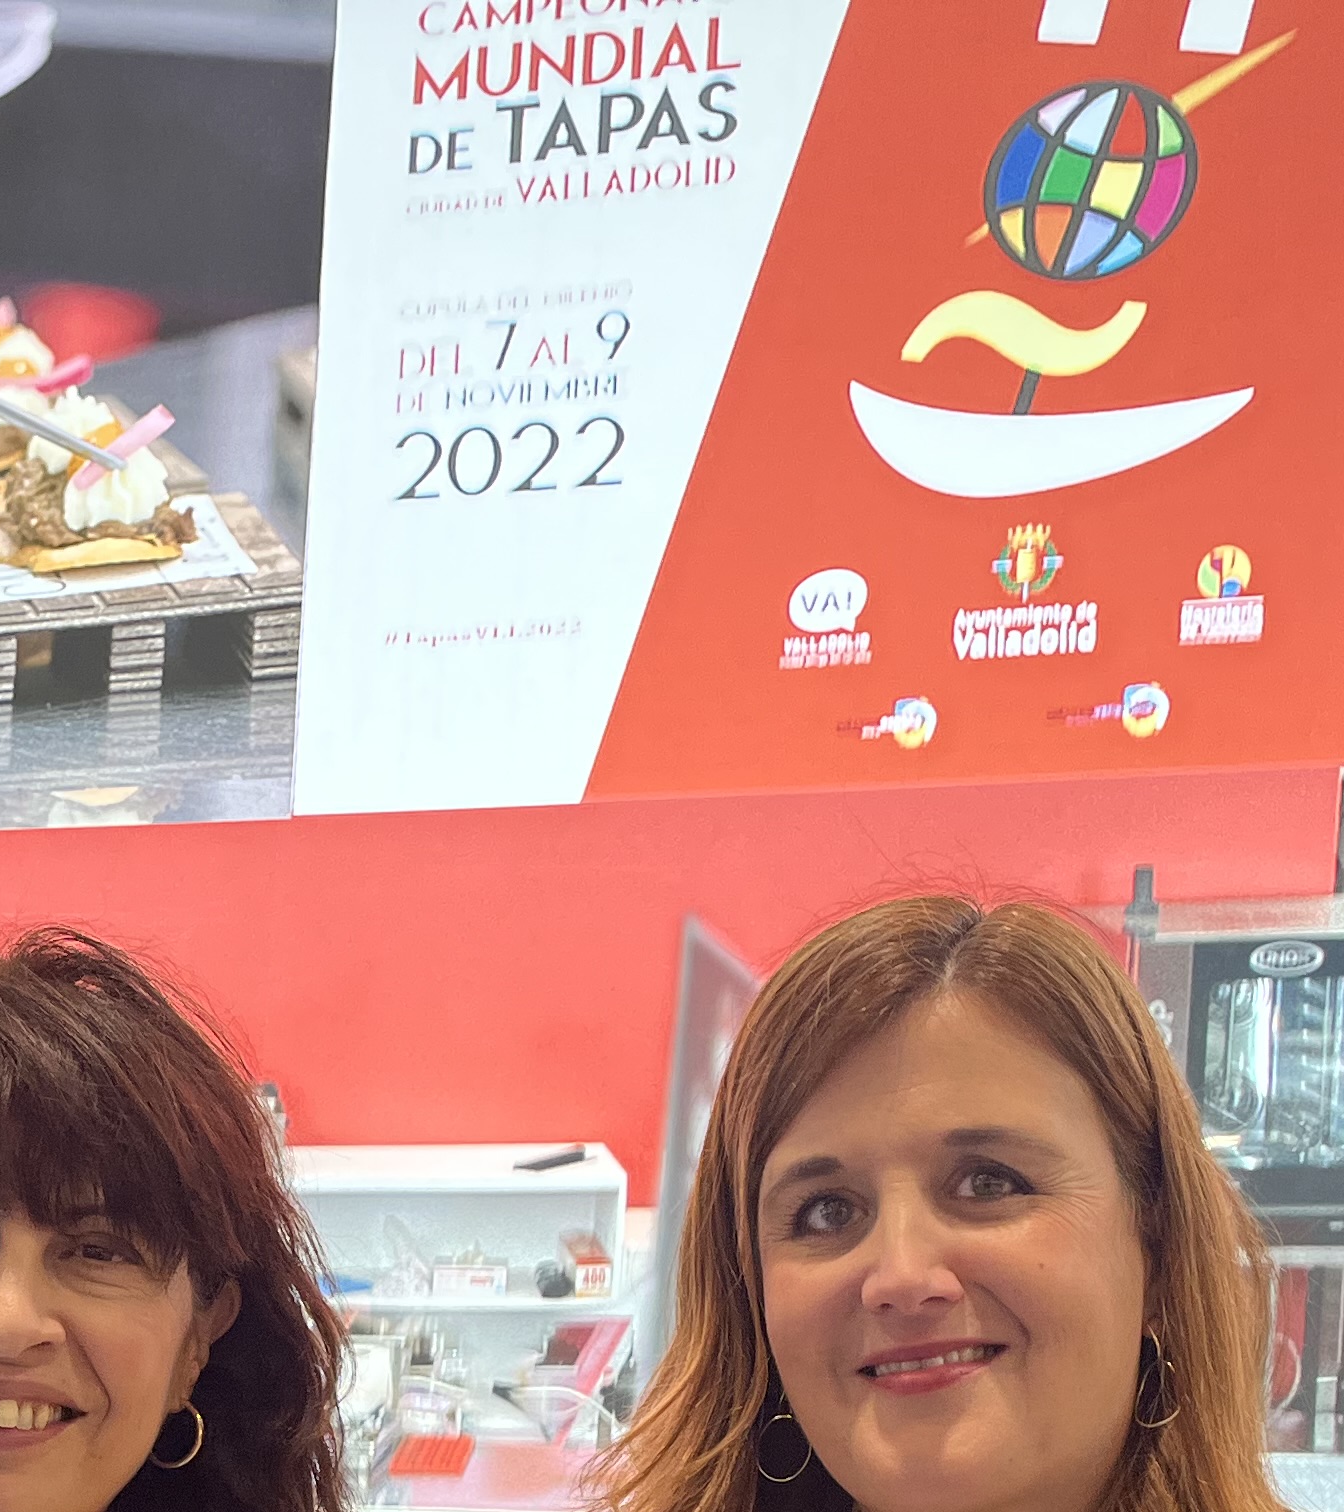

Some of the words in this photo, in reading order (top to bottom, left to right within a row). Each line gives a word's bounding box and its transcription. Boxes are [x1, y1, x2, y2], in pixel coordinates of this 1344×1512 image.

[413, 18, 741, 104] MUNDIAL
[409, 128, 474, 174] DE
[496, 76, 737, 163] TAPAS
[516, 155, 735, 203] VALLADOLID
[486, 319, 517, 370] 7
[596, 309, 630, 361] 9
[394, 416, 625, 501] 2022
[783, 632, 870, 654] VALLADOLID
[956, 621, 1097, 661] Valladolid
